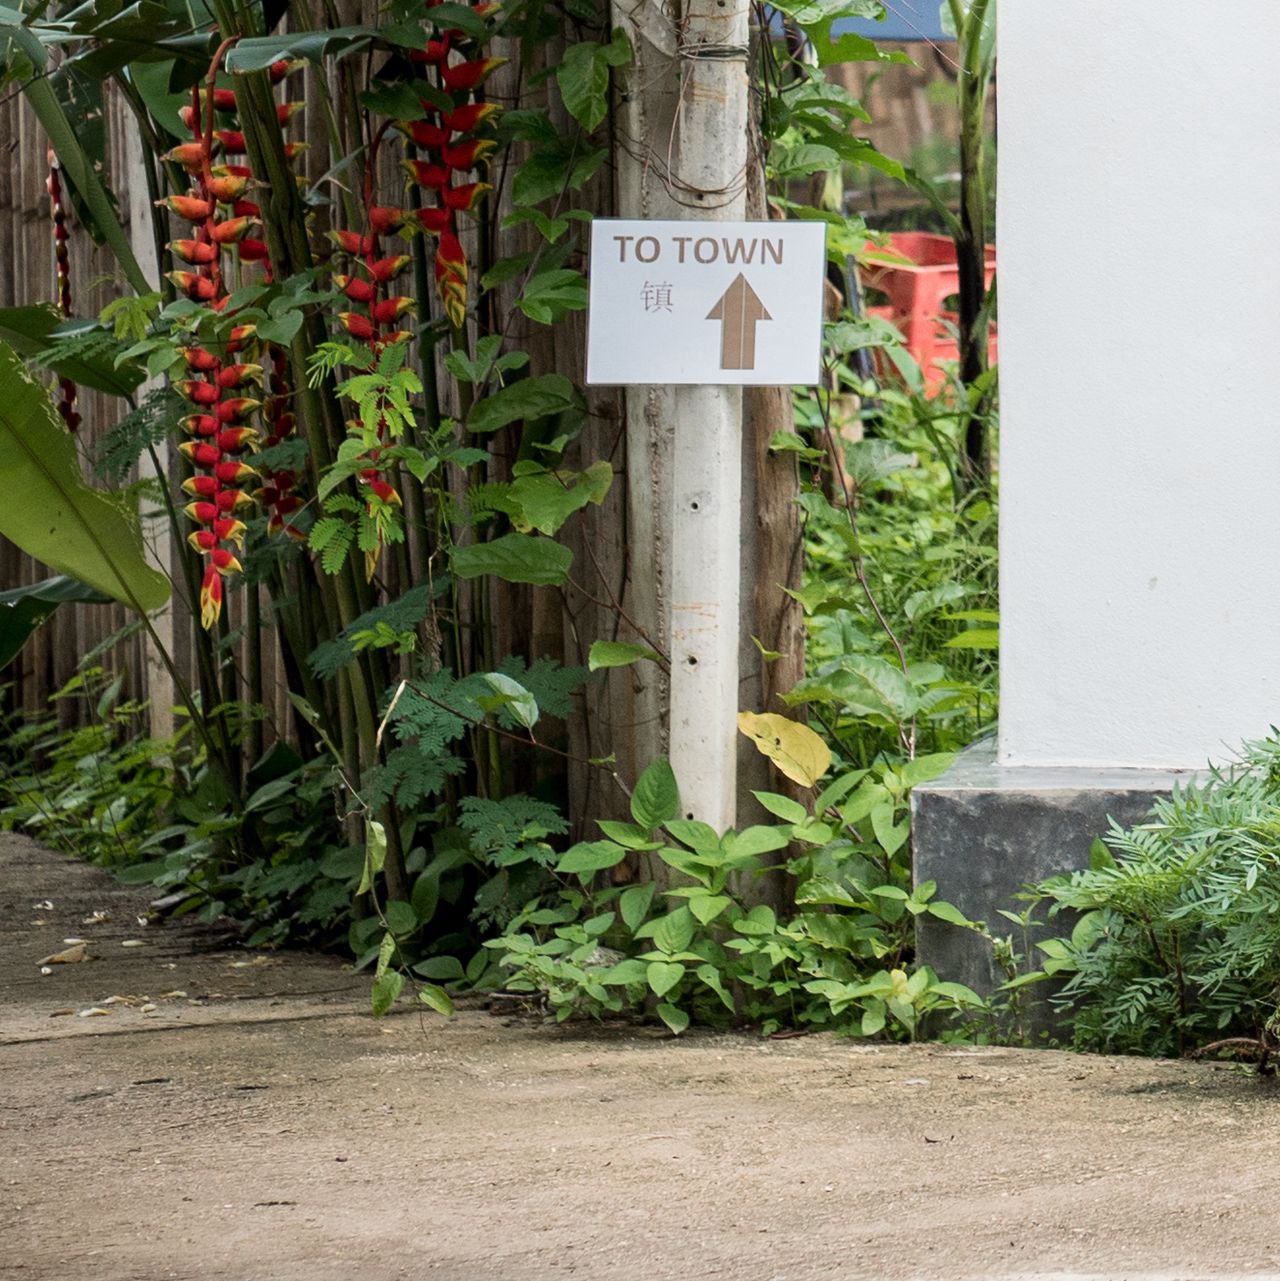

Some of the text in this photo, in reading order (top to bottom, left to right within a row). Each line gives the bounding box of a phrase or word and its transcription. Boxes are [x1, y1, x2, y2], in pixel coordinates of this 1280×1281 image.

[612, 235, 785, 265] TO TOWN
[639, 280, 674, 314] 镇
